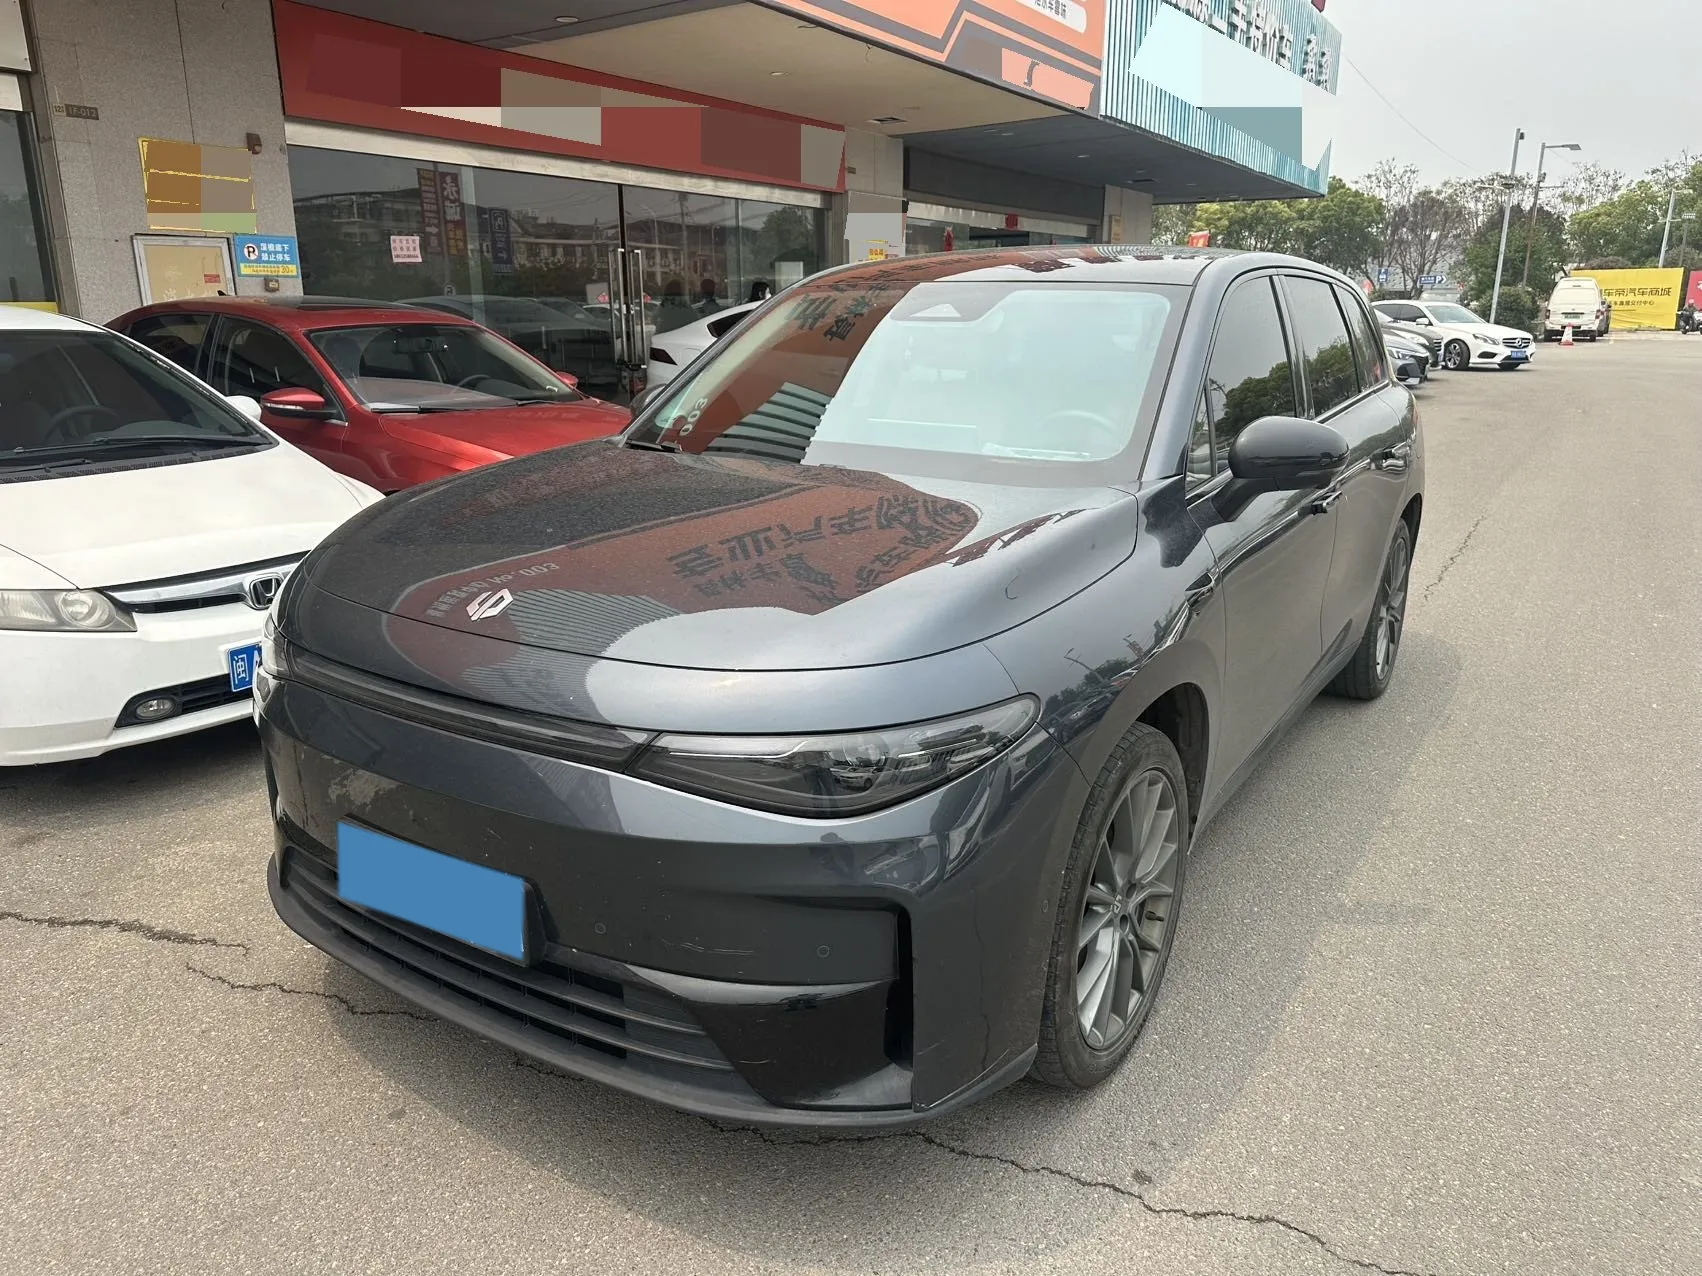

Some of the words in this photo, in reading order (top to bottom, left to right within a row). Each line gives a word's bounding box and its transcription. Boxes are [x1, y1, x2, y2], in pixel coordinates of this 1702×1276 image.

[1600, 286, 1672, 297] 车帝汽车商城
